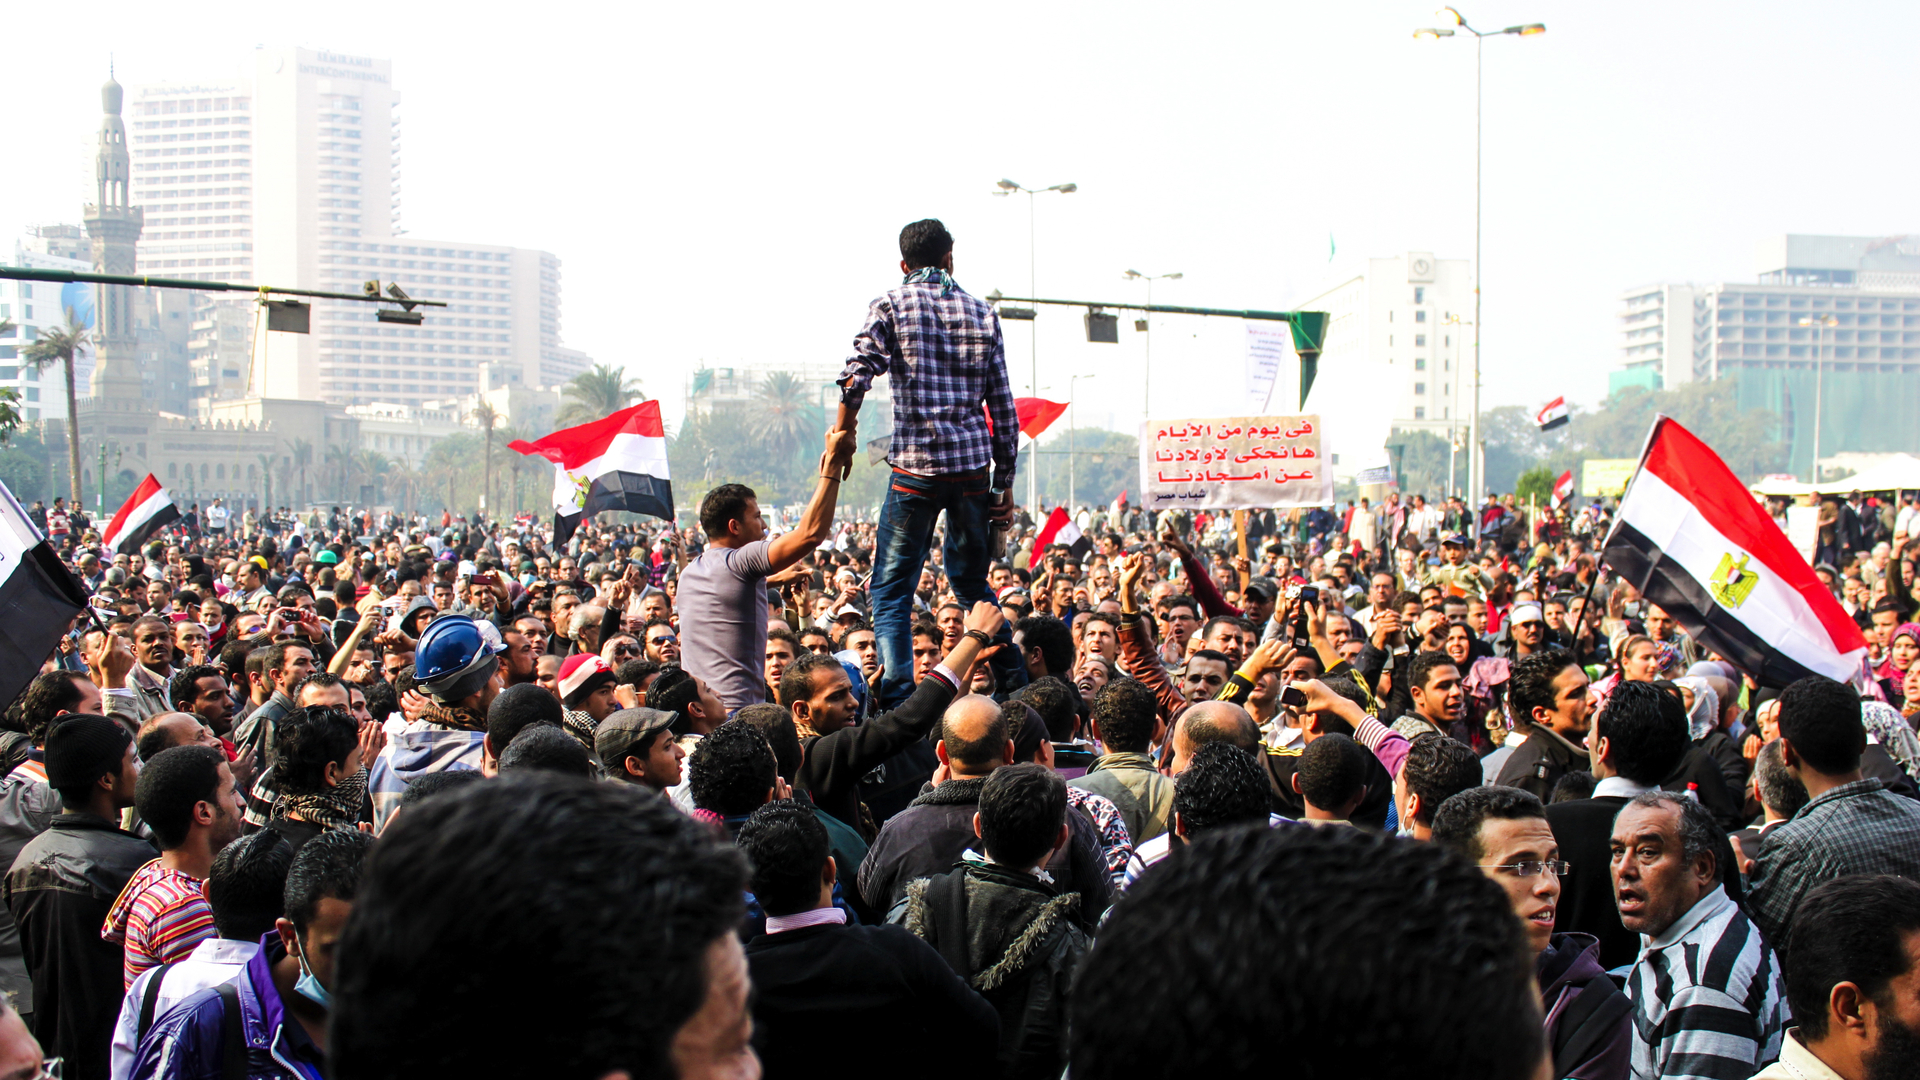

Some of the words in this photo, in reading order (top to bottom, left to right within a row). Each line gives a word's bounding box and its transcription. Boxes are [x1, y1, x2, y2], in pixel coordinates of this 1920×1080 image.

[1157, 422, 1211, 442] الأيام
[1217, 424, 1242, 439] من
[1247, 425, 1281, 439] يوم
[1158, 466, 1269, 484] أمجادنا
[1274, 468, 1314, 484] عن
[1155, 491, 1176, 502] مصر
[1178, 488, 1206, 500] شباب
